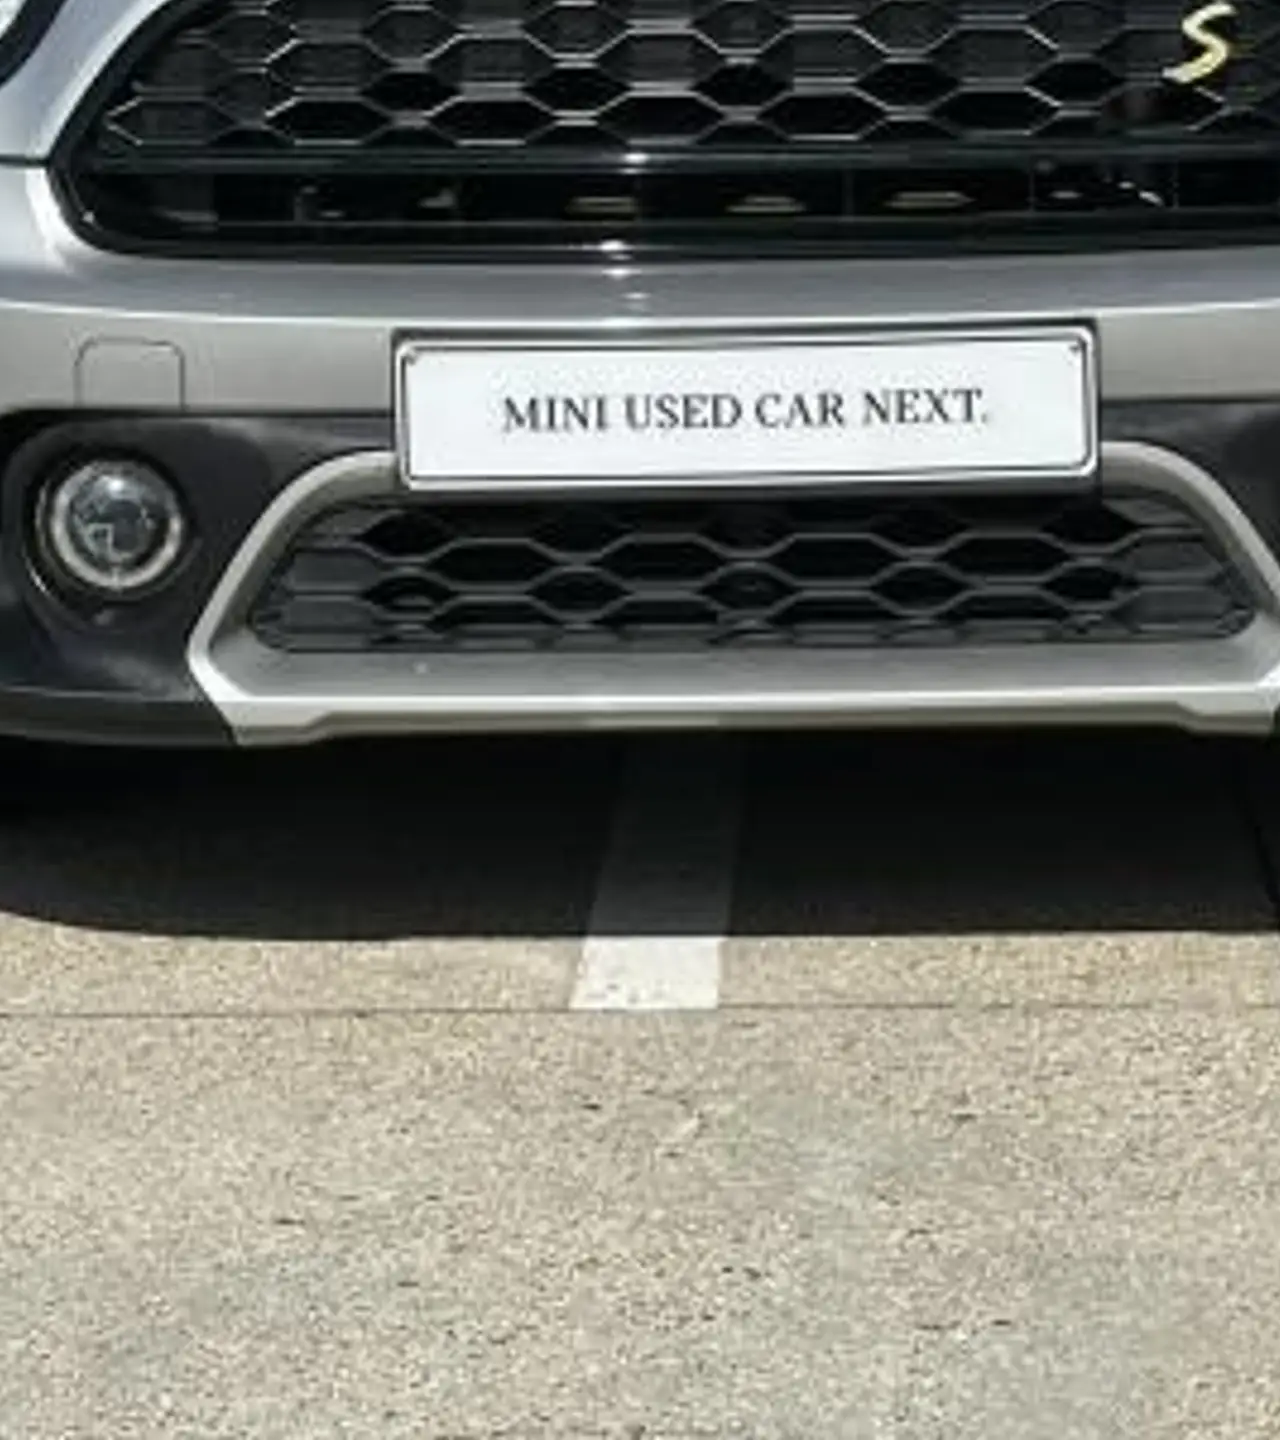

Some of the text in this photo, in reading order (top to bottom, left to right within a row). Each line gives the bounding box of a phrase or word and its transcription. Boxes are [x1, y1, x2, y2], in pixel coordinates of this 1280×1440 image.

[502, 394, 609, 433] MINI
[624, 392, 743, 431] USED
[754, 391, 845, 428] CAR
